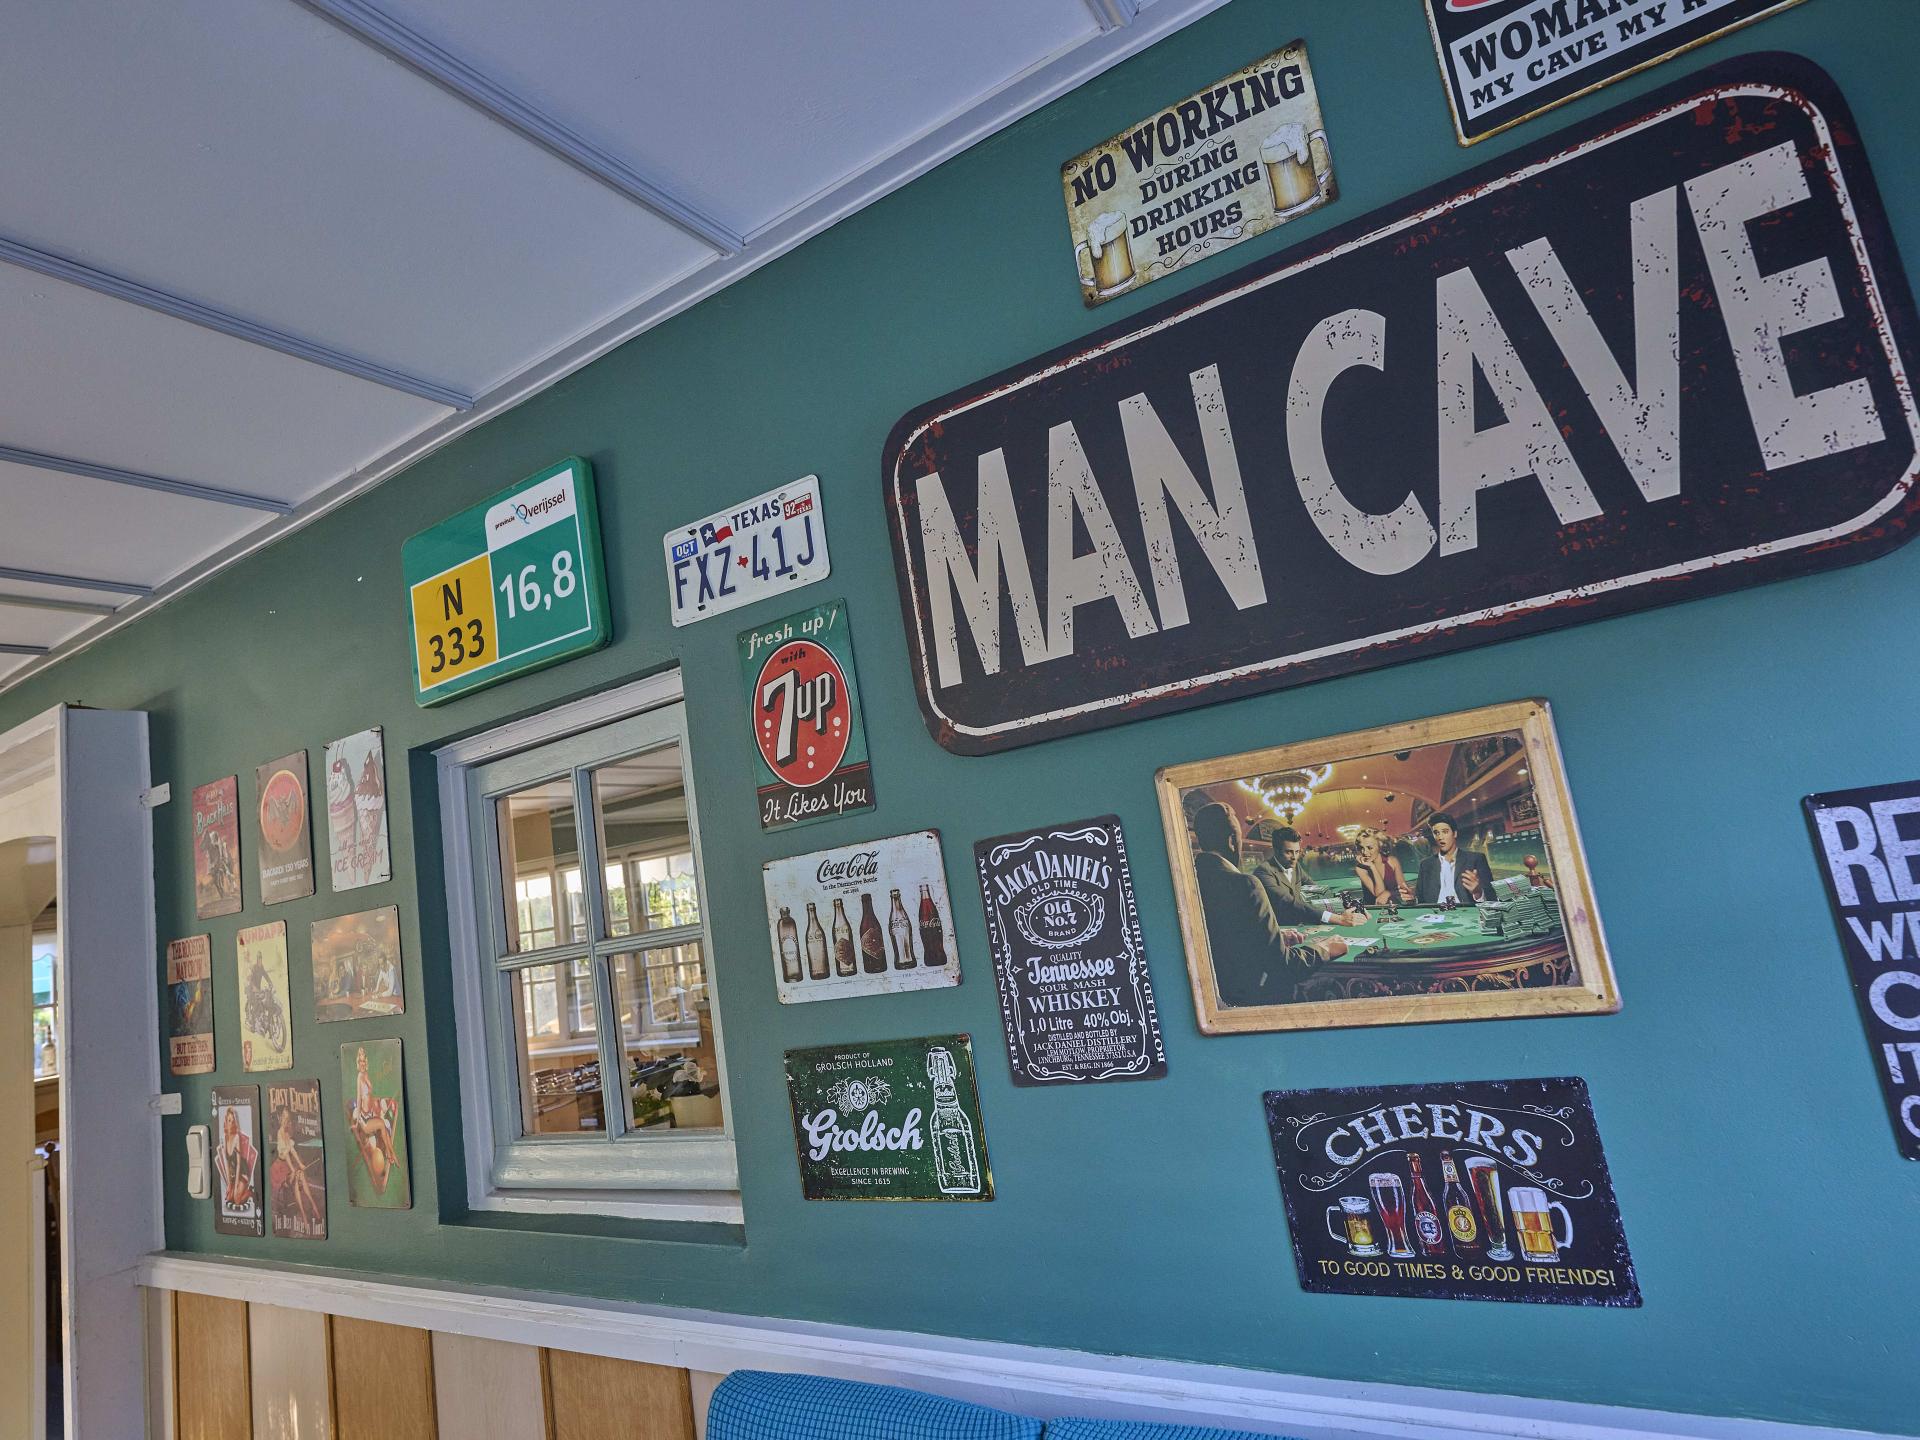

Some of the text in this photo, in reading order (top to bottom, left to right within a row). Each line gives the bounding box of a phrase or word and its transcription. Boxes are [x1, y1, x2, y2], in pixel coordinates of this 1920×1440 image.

[1470, 2, 1667, 109] MY CAVE MY
[1071, 64, 1305, 208] NO WORKING
[1139, 140, 1238, 204] DURING
[1130, 161, 1260, 239] DRINKING
[1156, 201, 1243, 256] HOURS
[915, 140, 1886, 690] MAN CAVE
[515, 489, 566, 520] Overijssel
[732, 498, 781, 532] TEXAS
[785, 501, 797, 517] 92
[674, 515, 815, 609] FXZ 41J
[676, 540, 695, 557] OCT
[442, 578, 463, 621] N
[499, 550, 576, 619] 16,8
[429, 618, 485, 674] 333
[748, 623, 793, 660] fresh
[781, 648, 806, 665] with
[763, 782, 867, 823] It Likes You
[994, 850, 1112, 906] JACK DANIEL'S
[1030, 880, 1078, 895] OLD TIME
[1044, 900, 1073, 916] Old
[1048, 927, 1077, 937] BRAND
[1113, 823, 1166, 1062] BOTTLED AT THE DISTILLERY
[978, 857, 1020, 1072] MADE IN TENNESSEE
[1027, 956, 1115, 984] Tennessee
[1050, 951, 1082, 963] QUALITY
[1027, 987, 1122, 1014] WHISKEY
[1039, 979, 1106, 993] SOUR MASH
[1029, 1009, 1134, 1036] 1,0 Litre 40% Obj.
[1048, 1032, 1073, 1042] DISTILLED
[1074, 1032, 1084, 1040] AND
[1085, 1029, 1109, 1039] BOTTLED
[1033, 1035, 1137, 1053] JACK DANIEL DISTILLERY
[816, 1058, 893, 1072] GROLSCH HOLLAND
[802, 1107, 924, 1162] Grolsch
[1325, 1102, 1543, 1167] CHEERS
[831, 1167, 910, 1176] EXCELLENCE IN BREWING
[874, 1177, 891, 1185] 1615
[1318, 1260, 1616, 1287] TO GOOD TIMES & GOOD FRIENDS!
